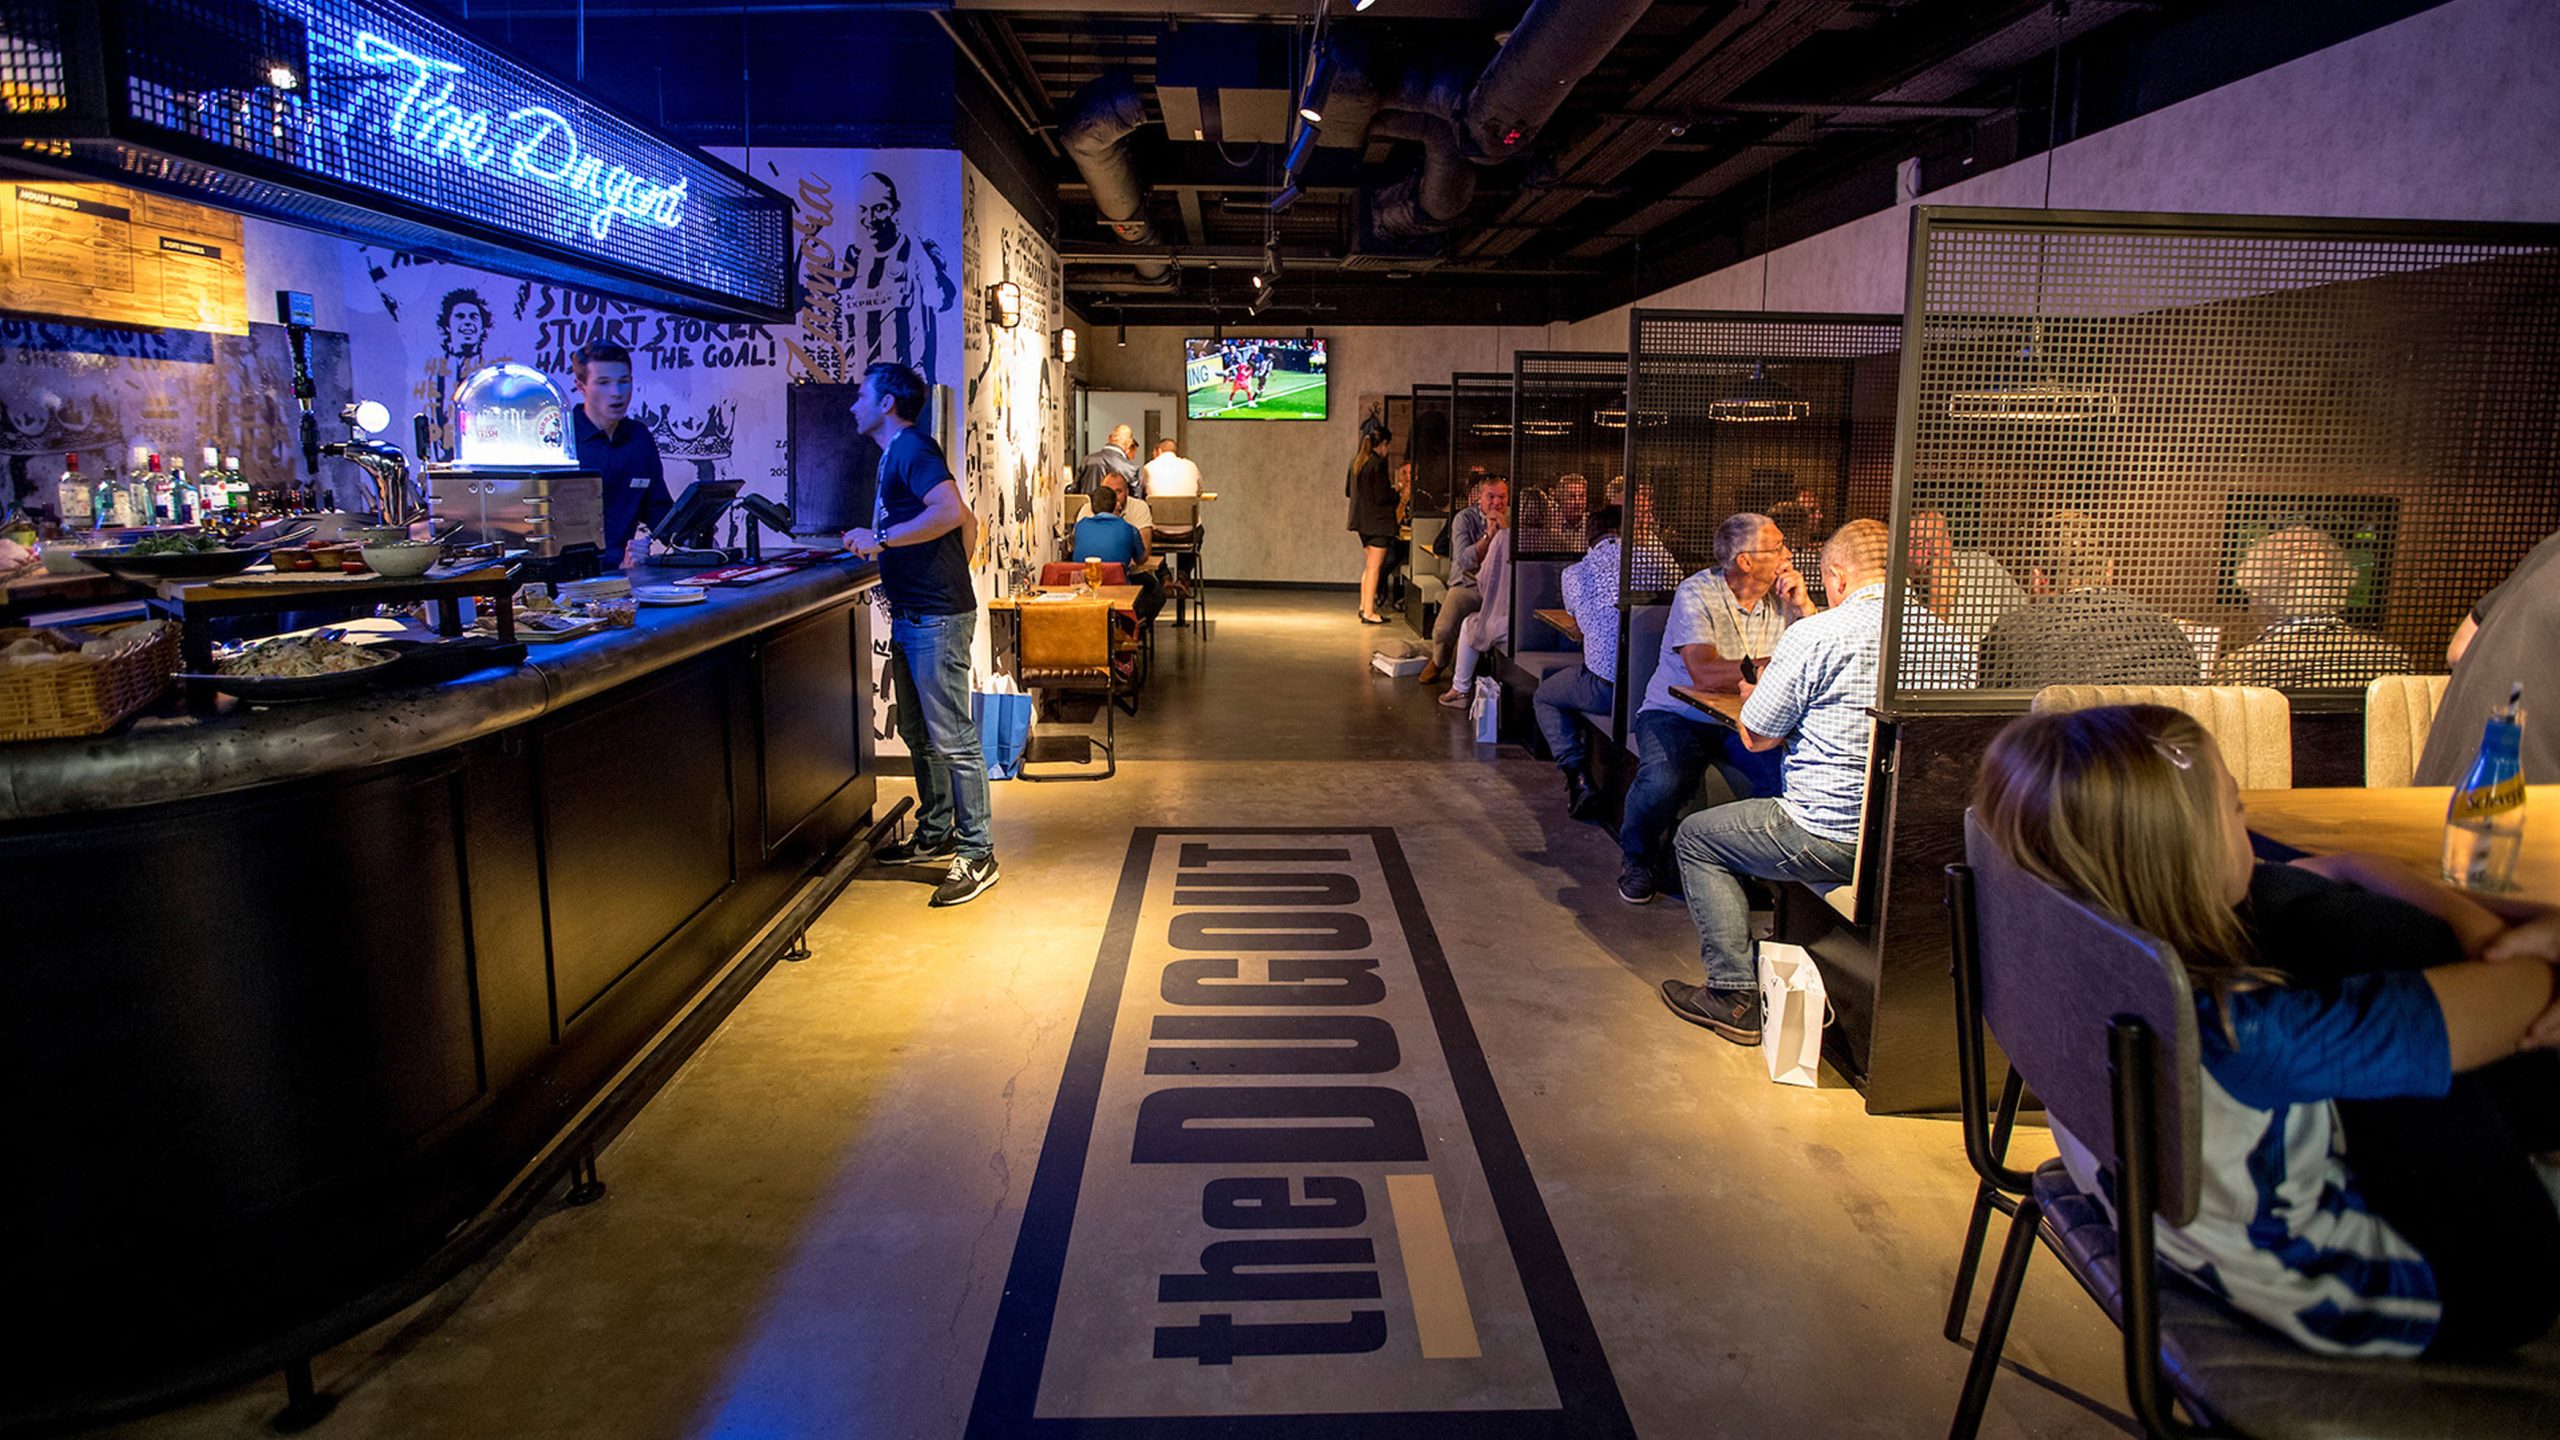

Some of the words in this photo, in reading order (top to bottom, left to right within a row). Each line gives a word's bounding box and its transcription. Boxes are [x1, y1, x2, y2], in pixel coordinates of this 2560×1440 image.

[355, 31, 494, 170] The
[535, 315, 646, 350] STUART
[641, 344, 694, 371] THE
[703, 341, 776, 368] GOAL!
[1131, 843, 1429, 1164] DUGOUT
[1152, 1176, 1388, 1366] the
